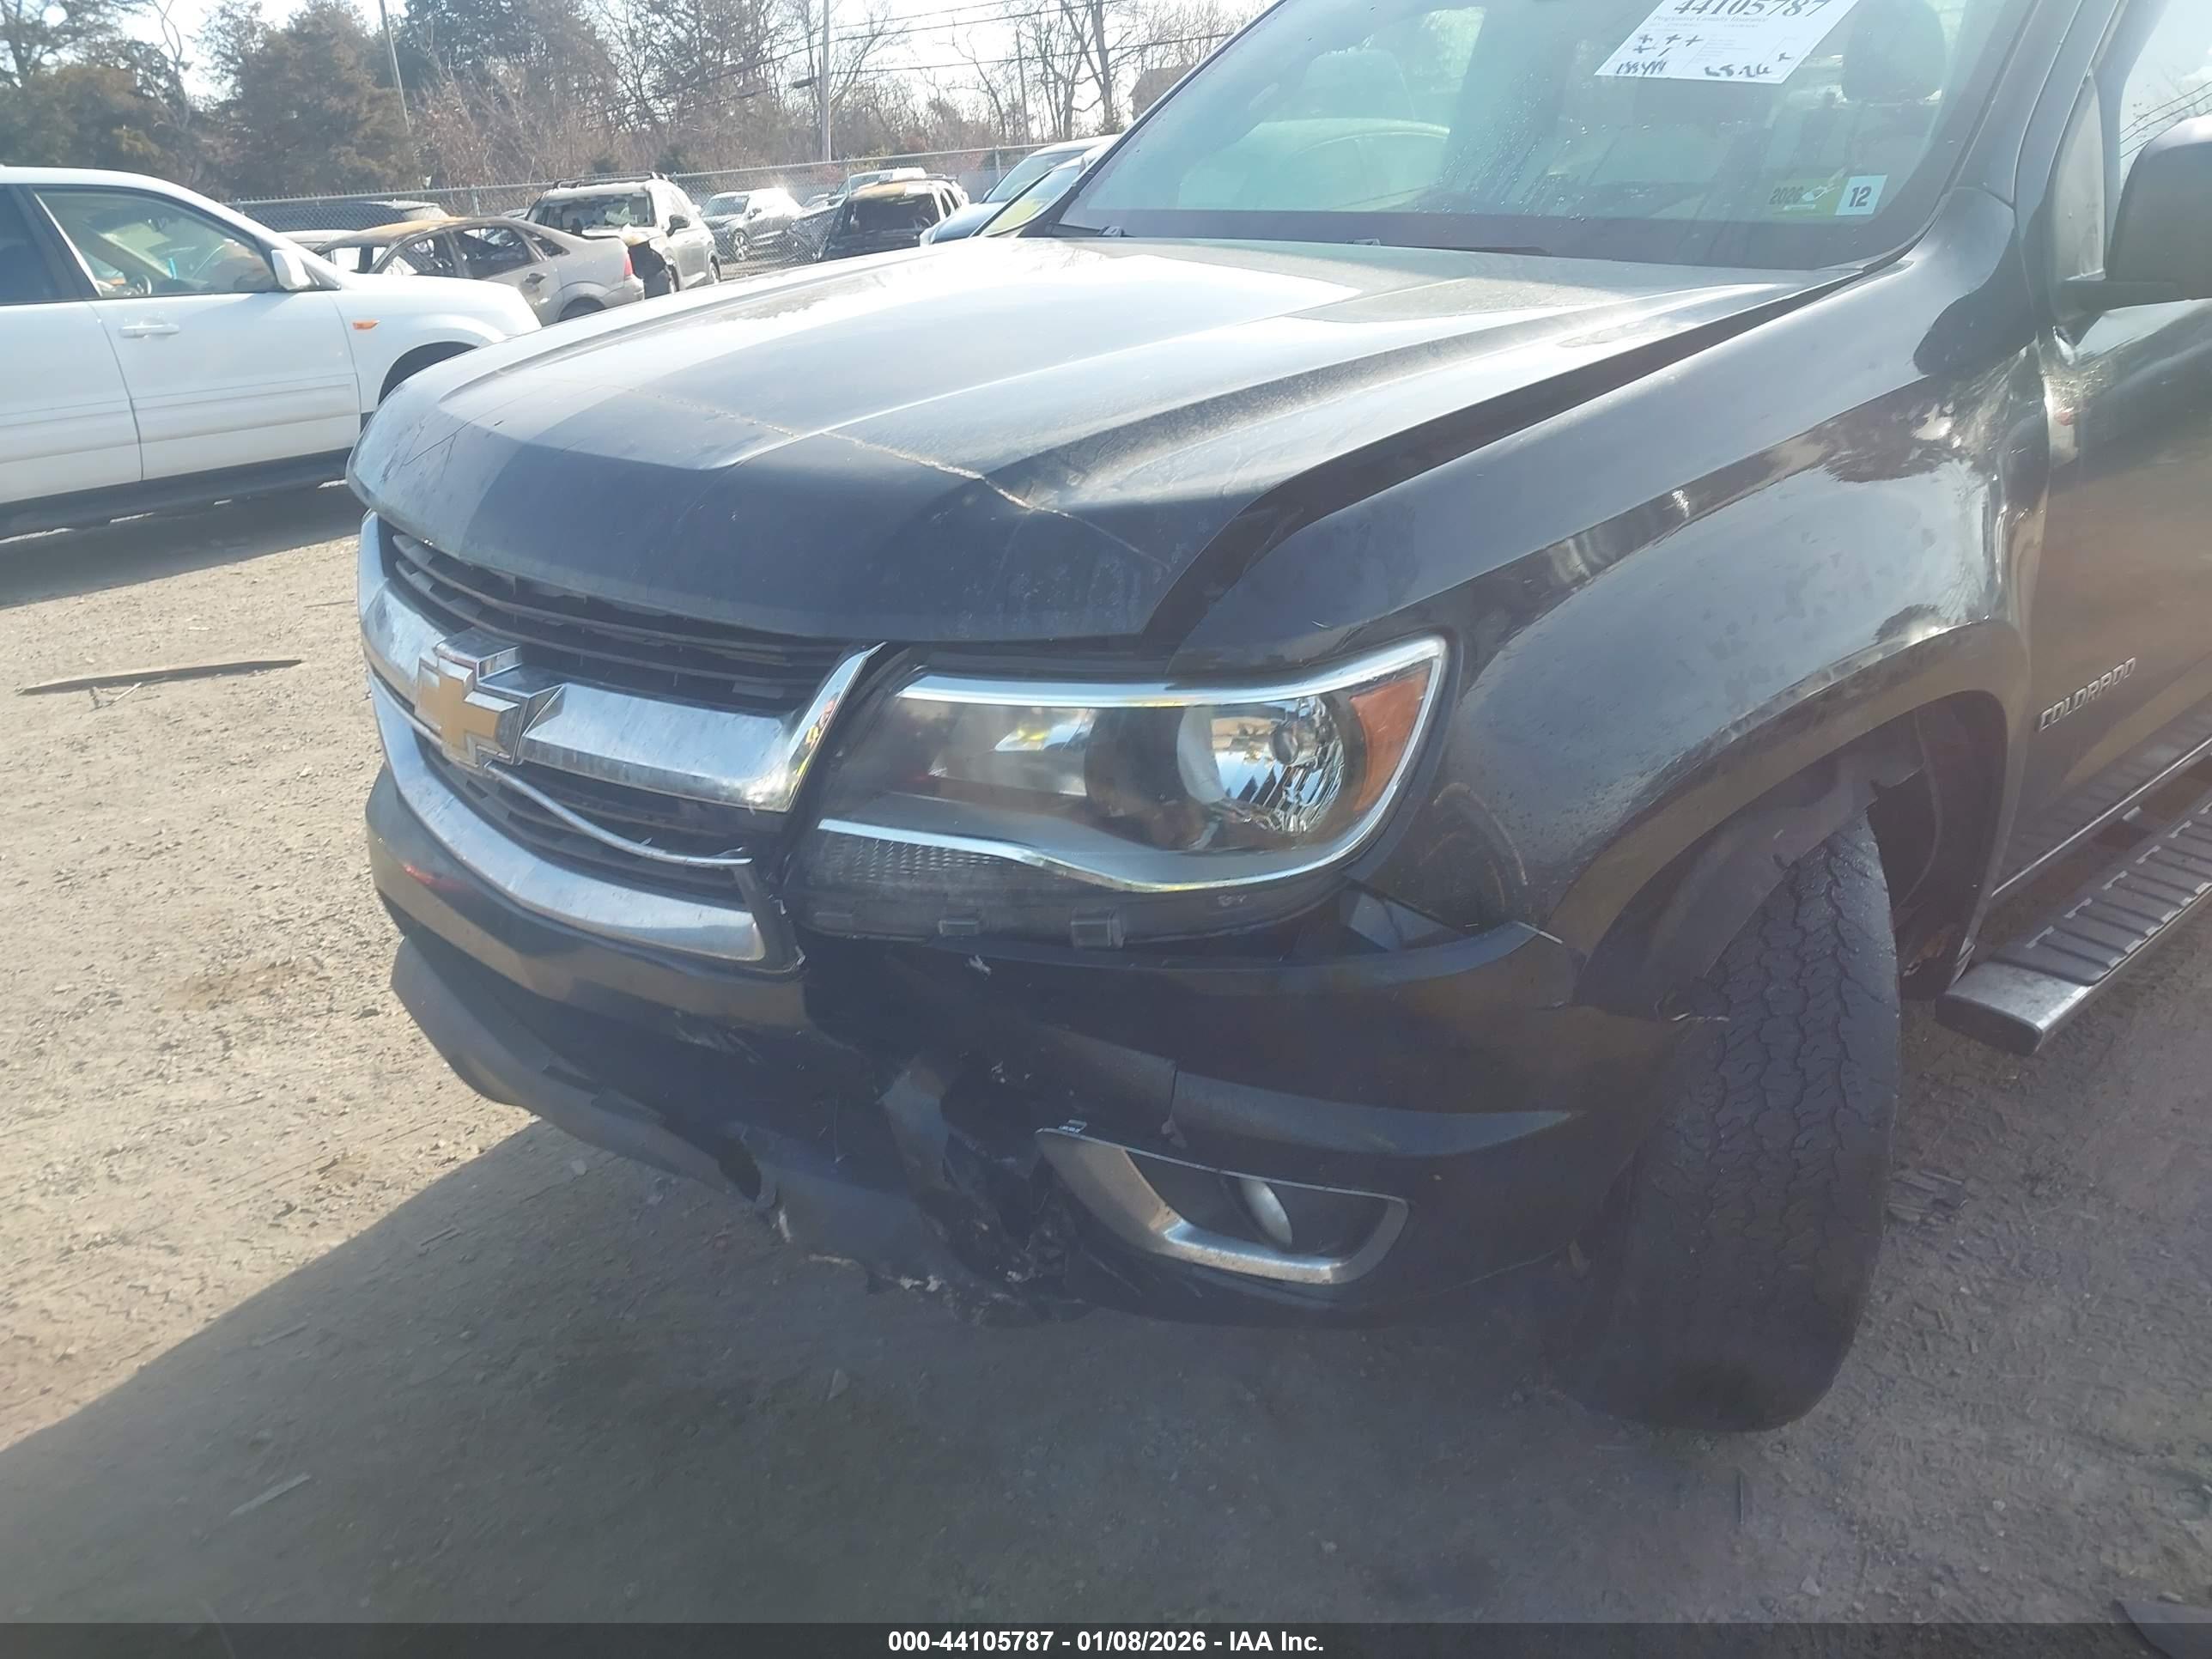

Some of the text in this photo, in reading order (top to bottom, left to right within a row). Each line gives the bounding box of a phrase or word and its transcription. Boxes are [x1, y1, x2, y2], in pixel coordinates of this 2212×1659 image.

[1674, 0, 1831, 17] 44105787
[1848, 185, 1872, 208] 12
[2039, 657, 2136, 732] COLORADO
